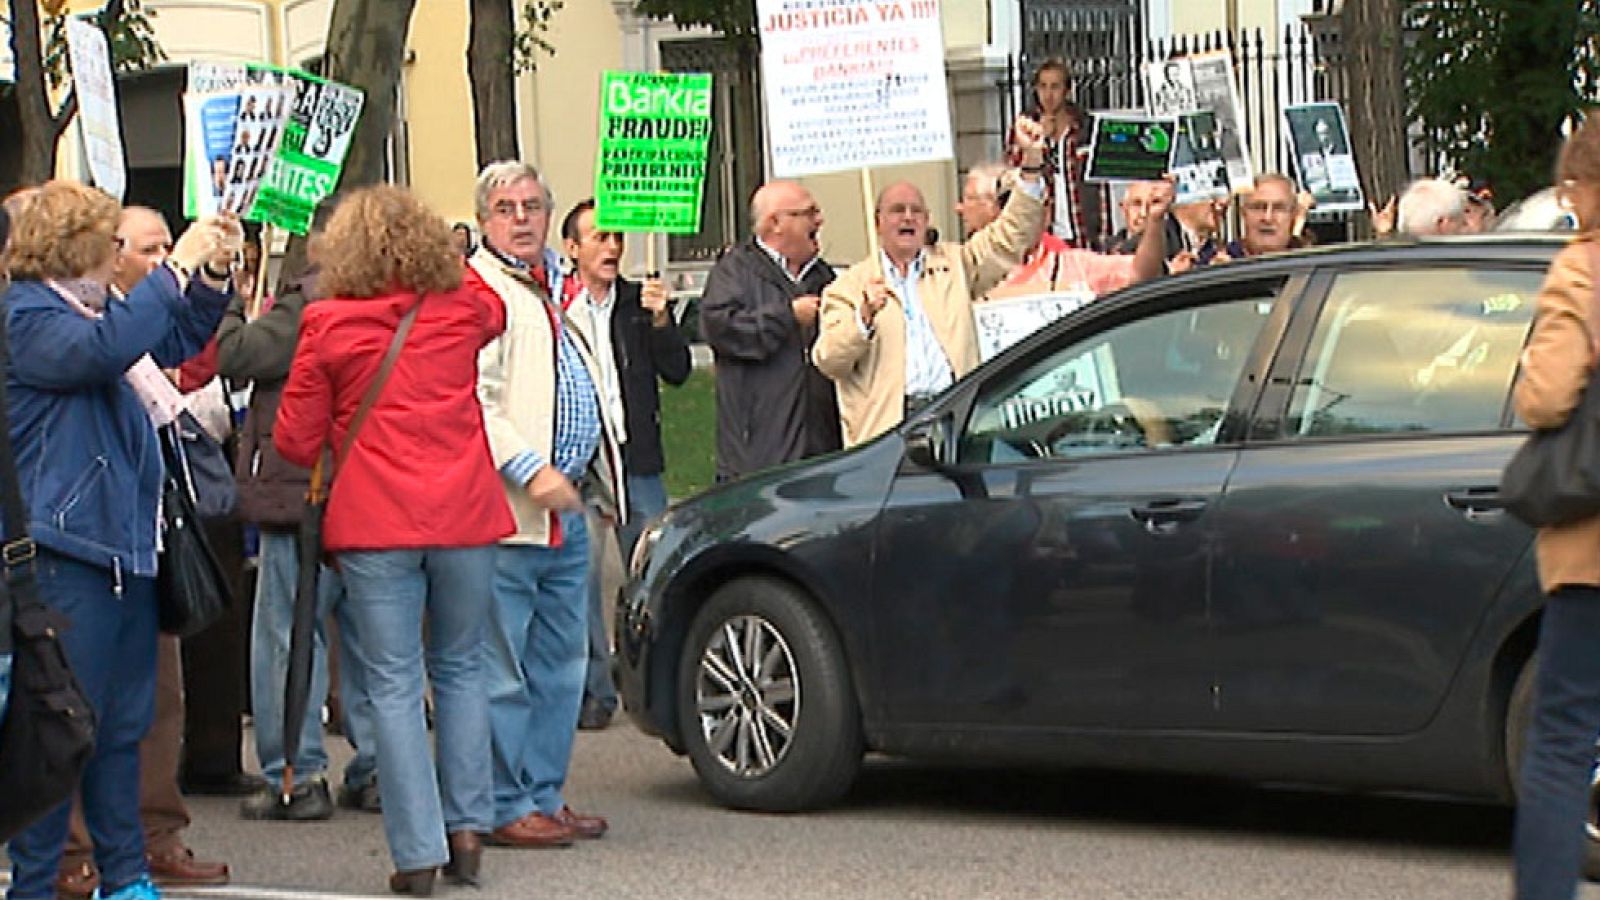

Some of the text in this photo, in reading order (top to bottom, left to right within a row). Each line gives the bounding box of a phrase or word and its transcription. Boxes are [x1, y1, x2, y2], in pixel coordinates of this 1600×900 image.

[765, 8, 869, 32] JUSTICIA
[876, 4, 905, 22] YA
[608, 80, 711, 115] Bankia
